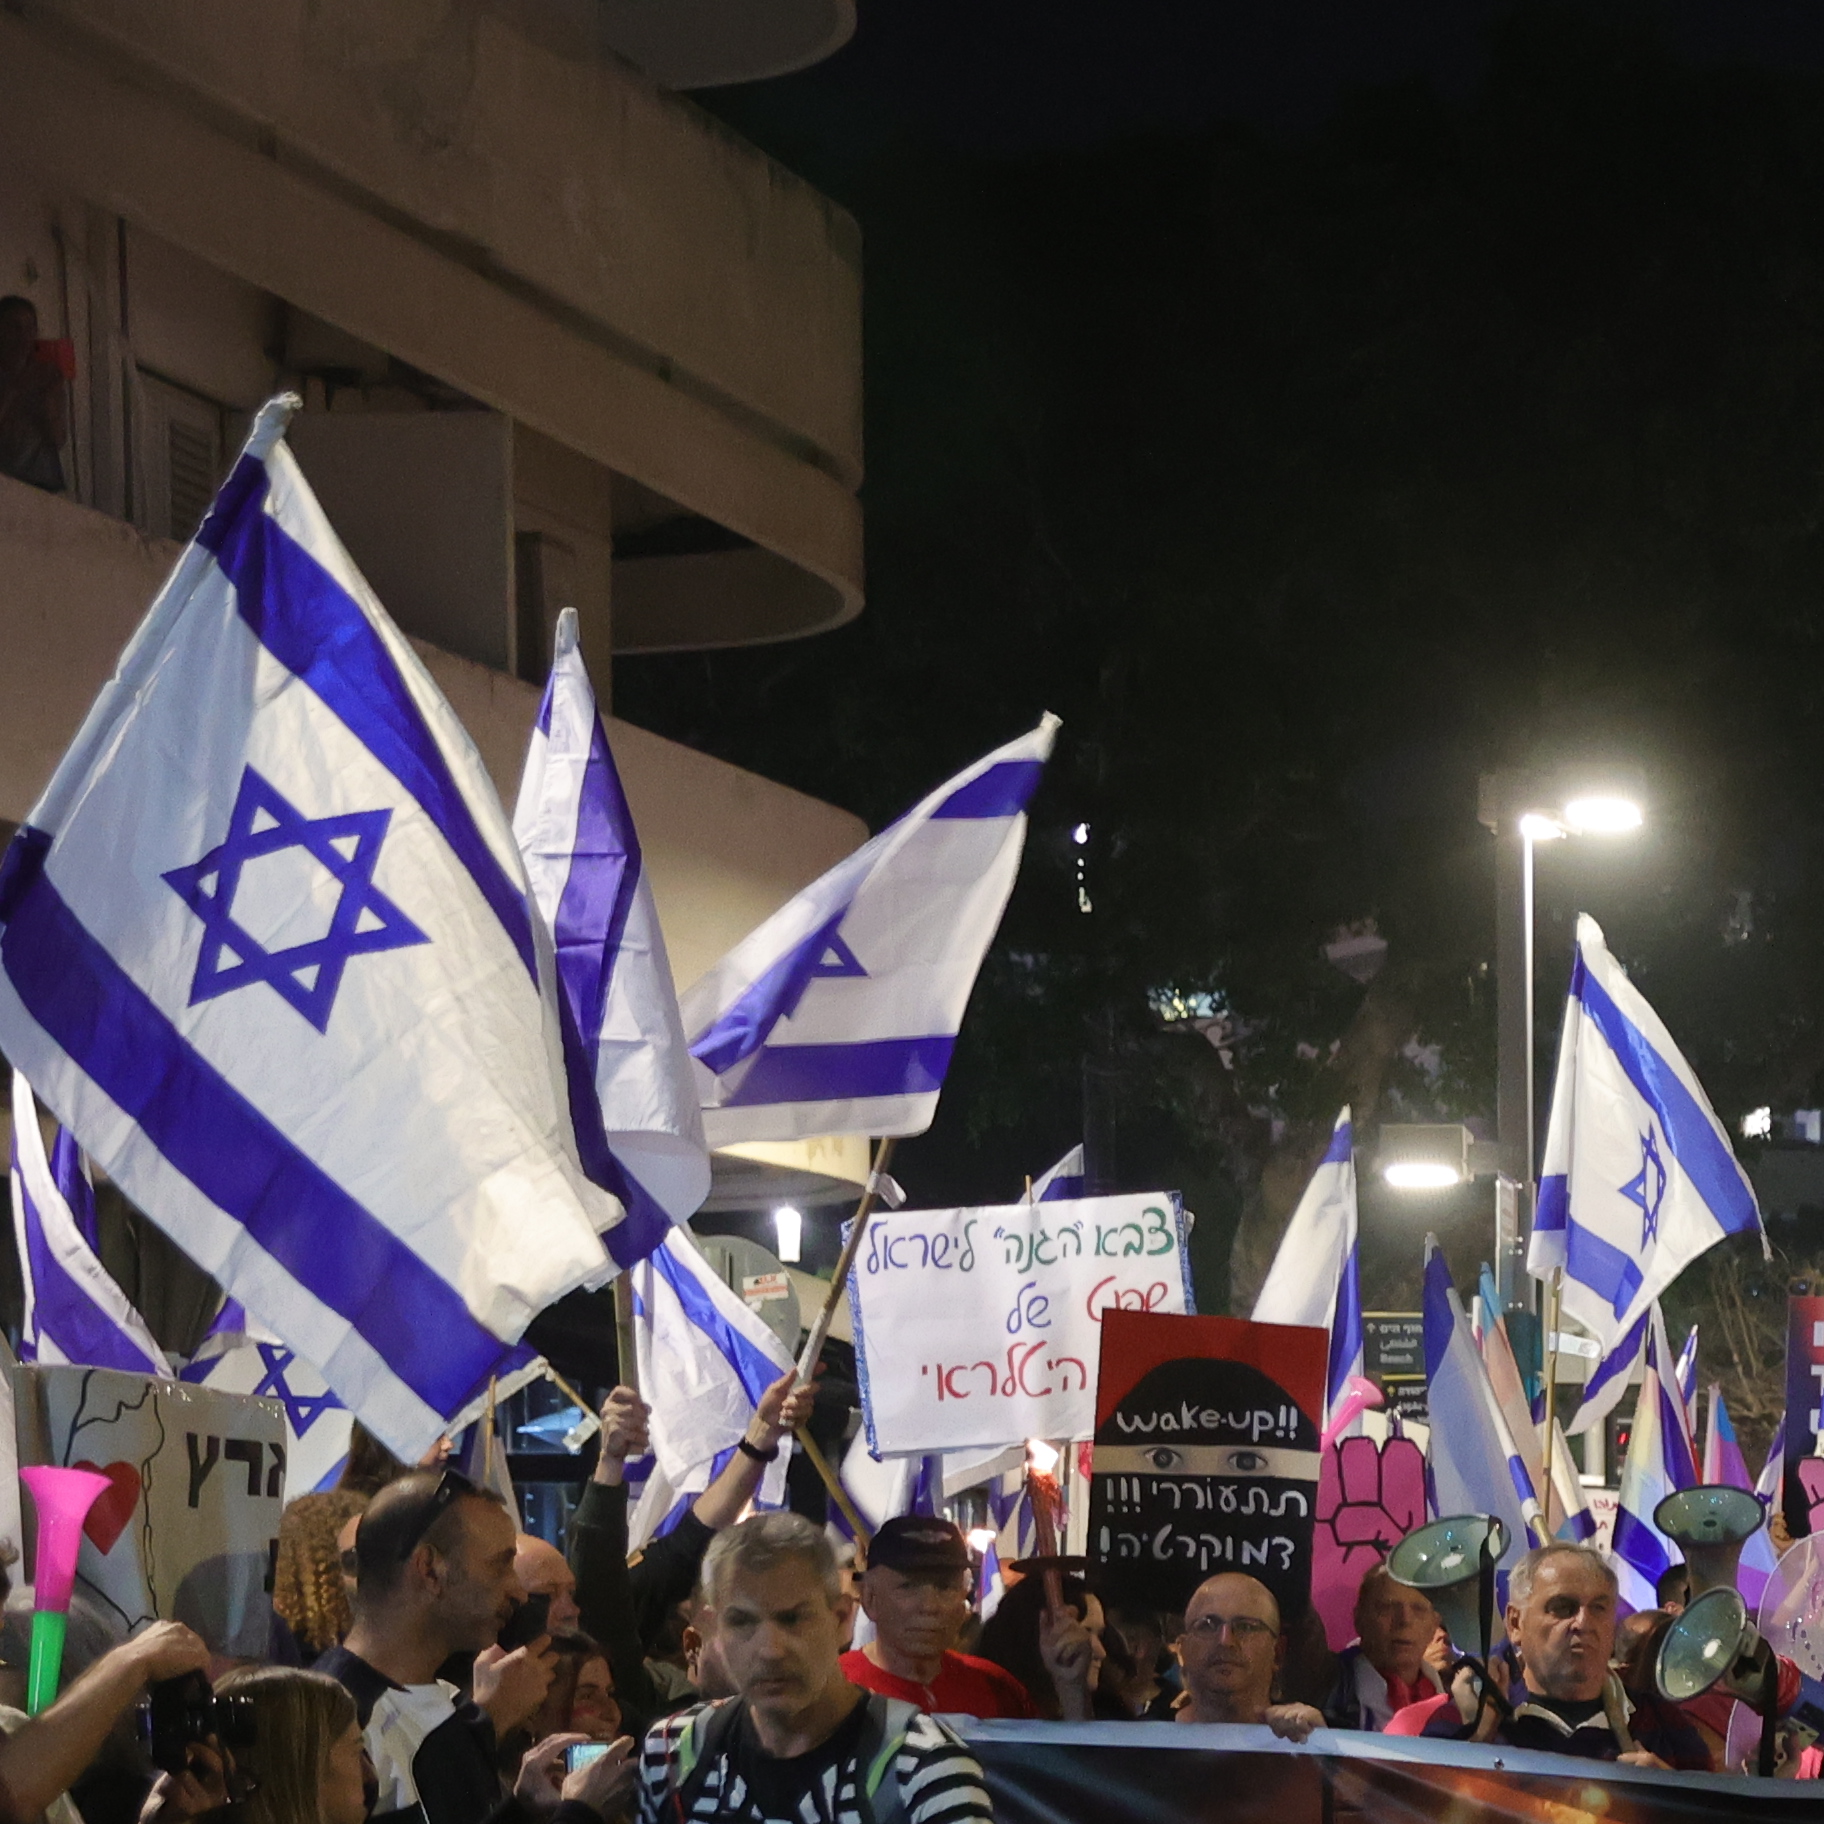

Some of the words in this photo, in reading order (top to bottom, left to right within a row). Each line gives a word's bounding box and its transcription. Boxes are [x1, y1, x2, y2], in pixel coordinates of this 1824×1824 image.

[866, 1218, 978, 1275] לישראל
[1094, 1206, 1175, 1258] צבא
[1006, 1281, 1052, 1334] של
